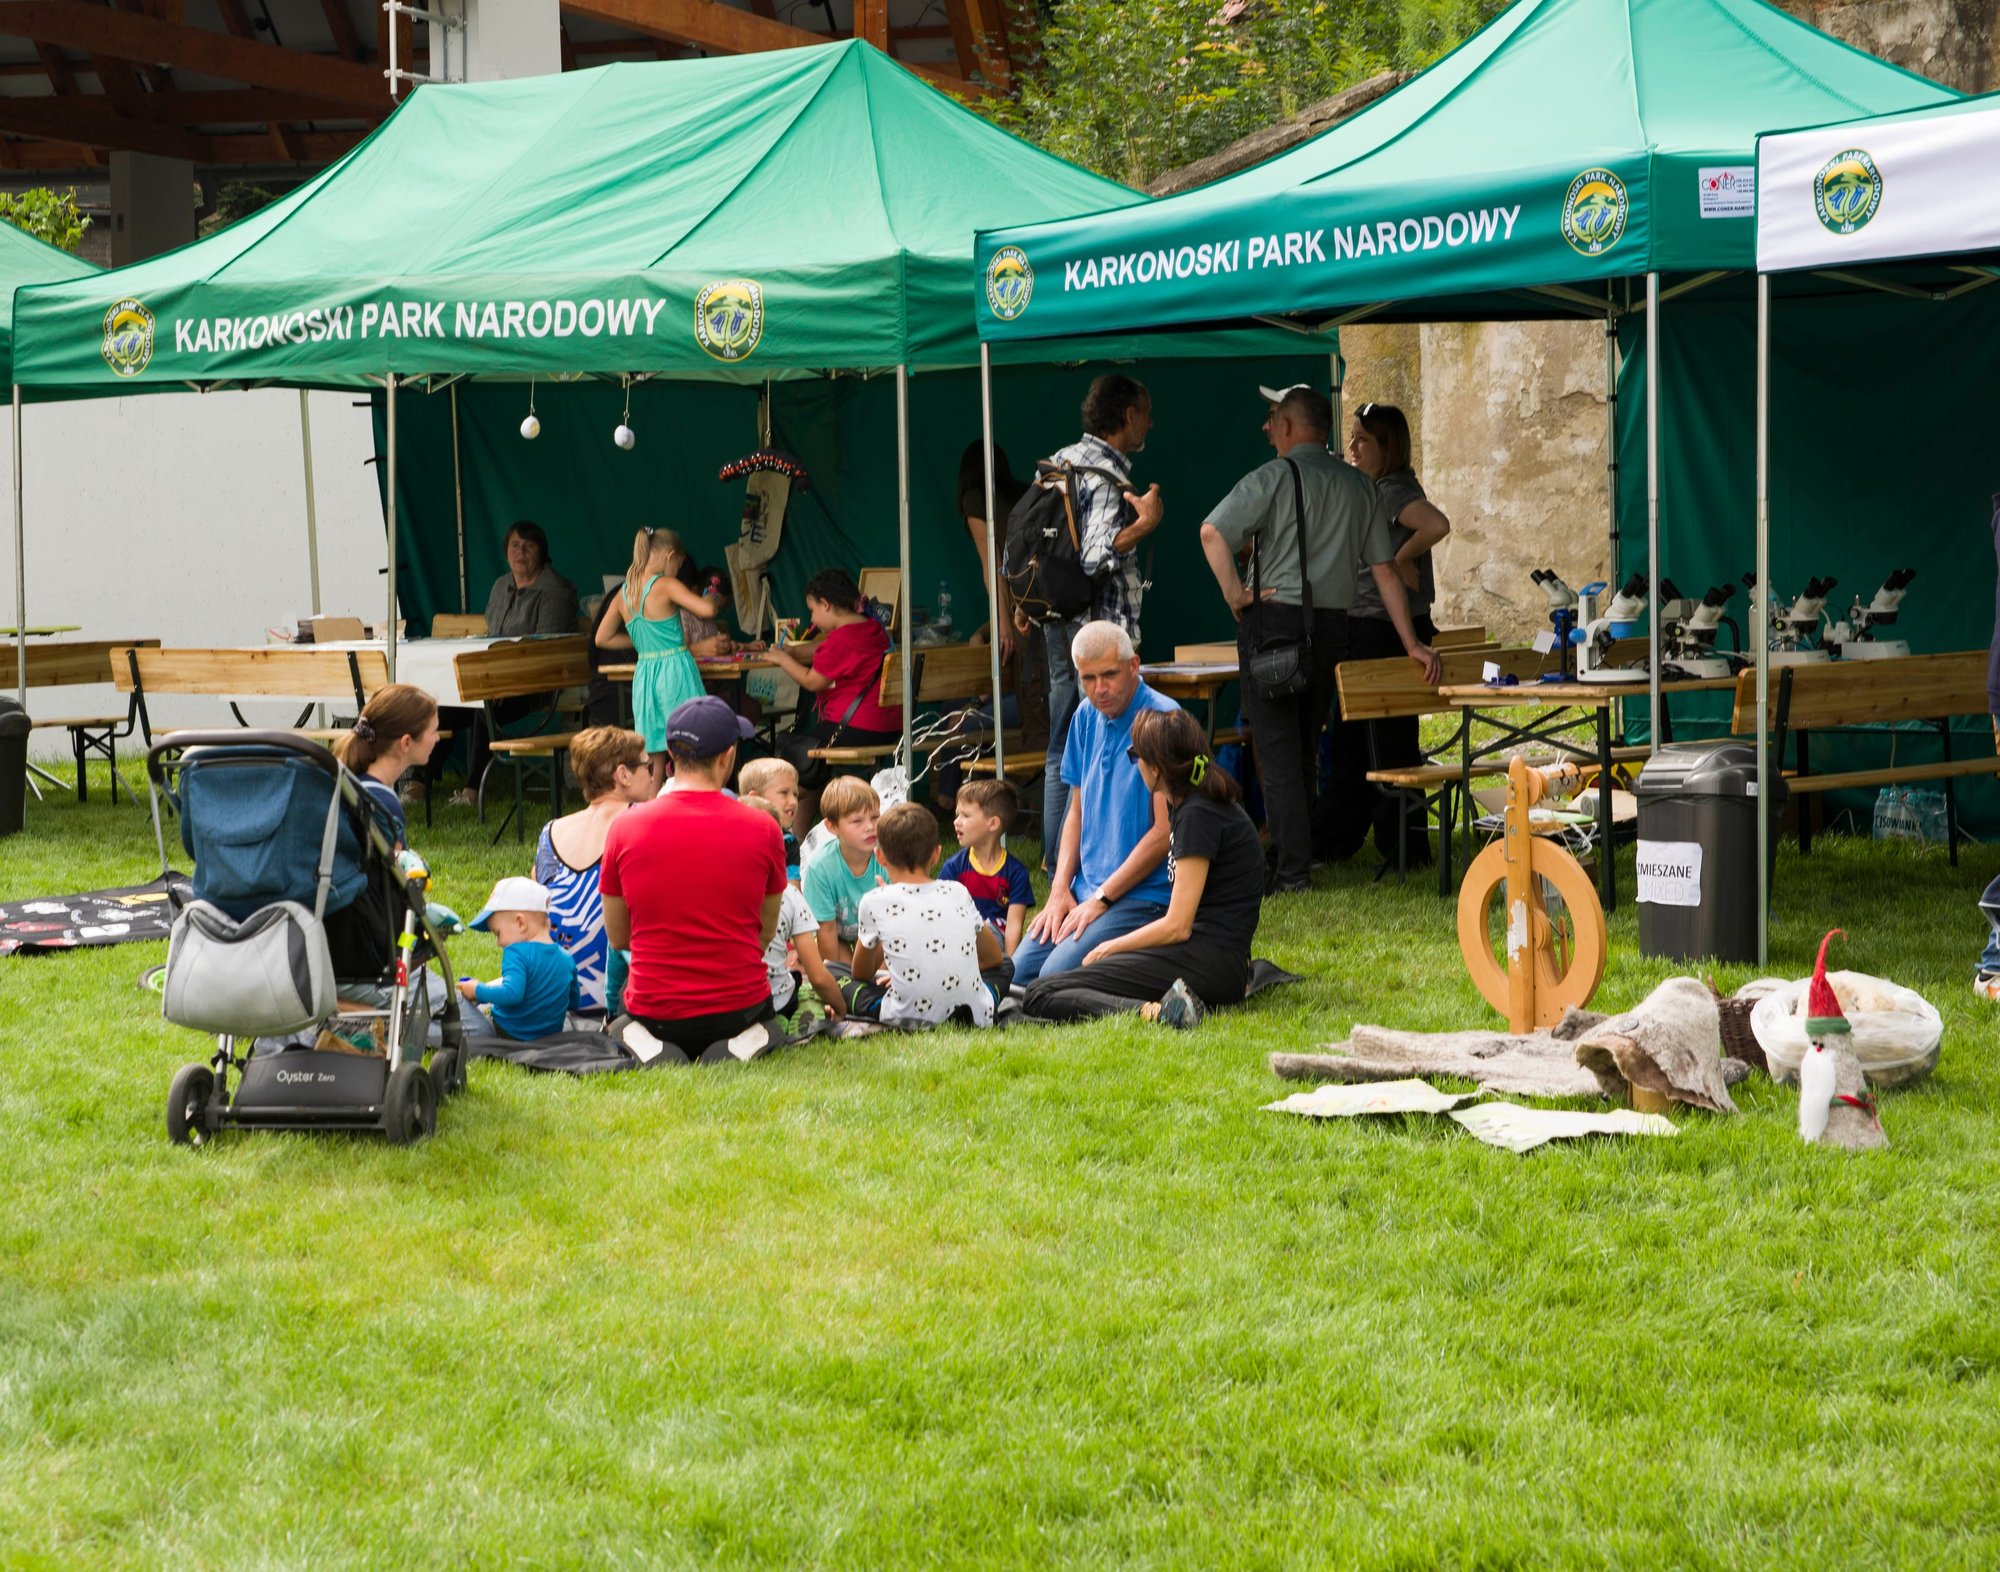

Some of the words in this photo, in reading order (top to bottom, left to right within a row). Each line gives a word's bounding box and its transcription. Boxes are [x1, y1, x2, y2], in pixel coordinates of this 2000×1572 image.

[1564, 179, 1584, 244] KARKONOSKI
[1585, 172, 1607, 182] PARK
[1608, 177, 1626, 239] NARODOWY
[1842, 151, 1864, 161] PARK
[1861, 155, 1881, 220] NARODOWY
[1064, 240, 1240, 291] KARKONOSKI
[1248, 229, 1326, 270] PARK
[1334, 205, 1521, 260] NARODOWY
[175, 306, 353, 352] KARKONOSKI
[361, 301, 446, 339] PARK
[455, 298, 667, 338] NARODOWY
[277, 1070, 314, 1085] Oyster
[317, 1072, 335, 1082] Zero
